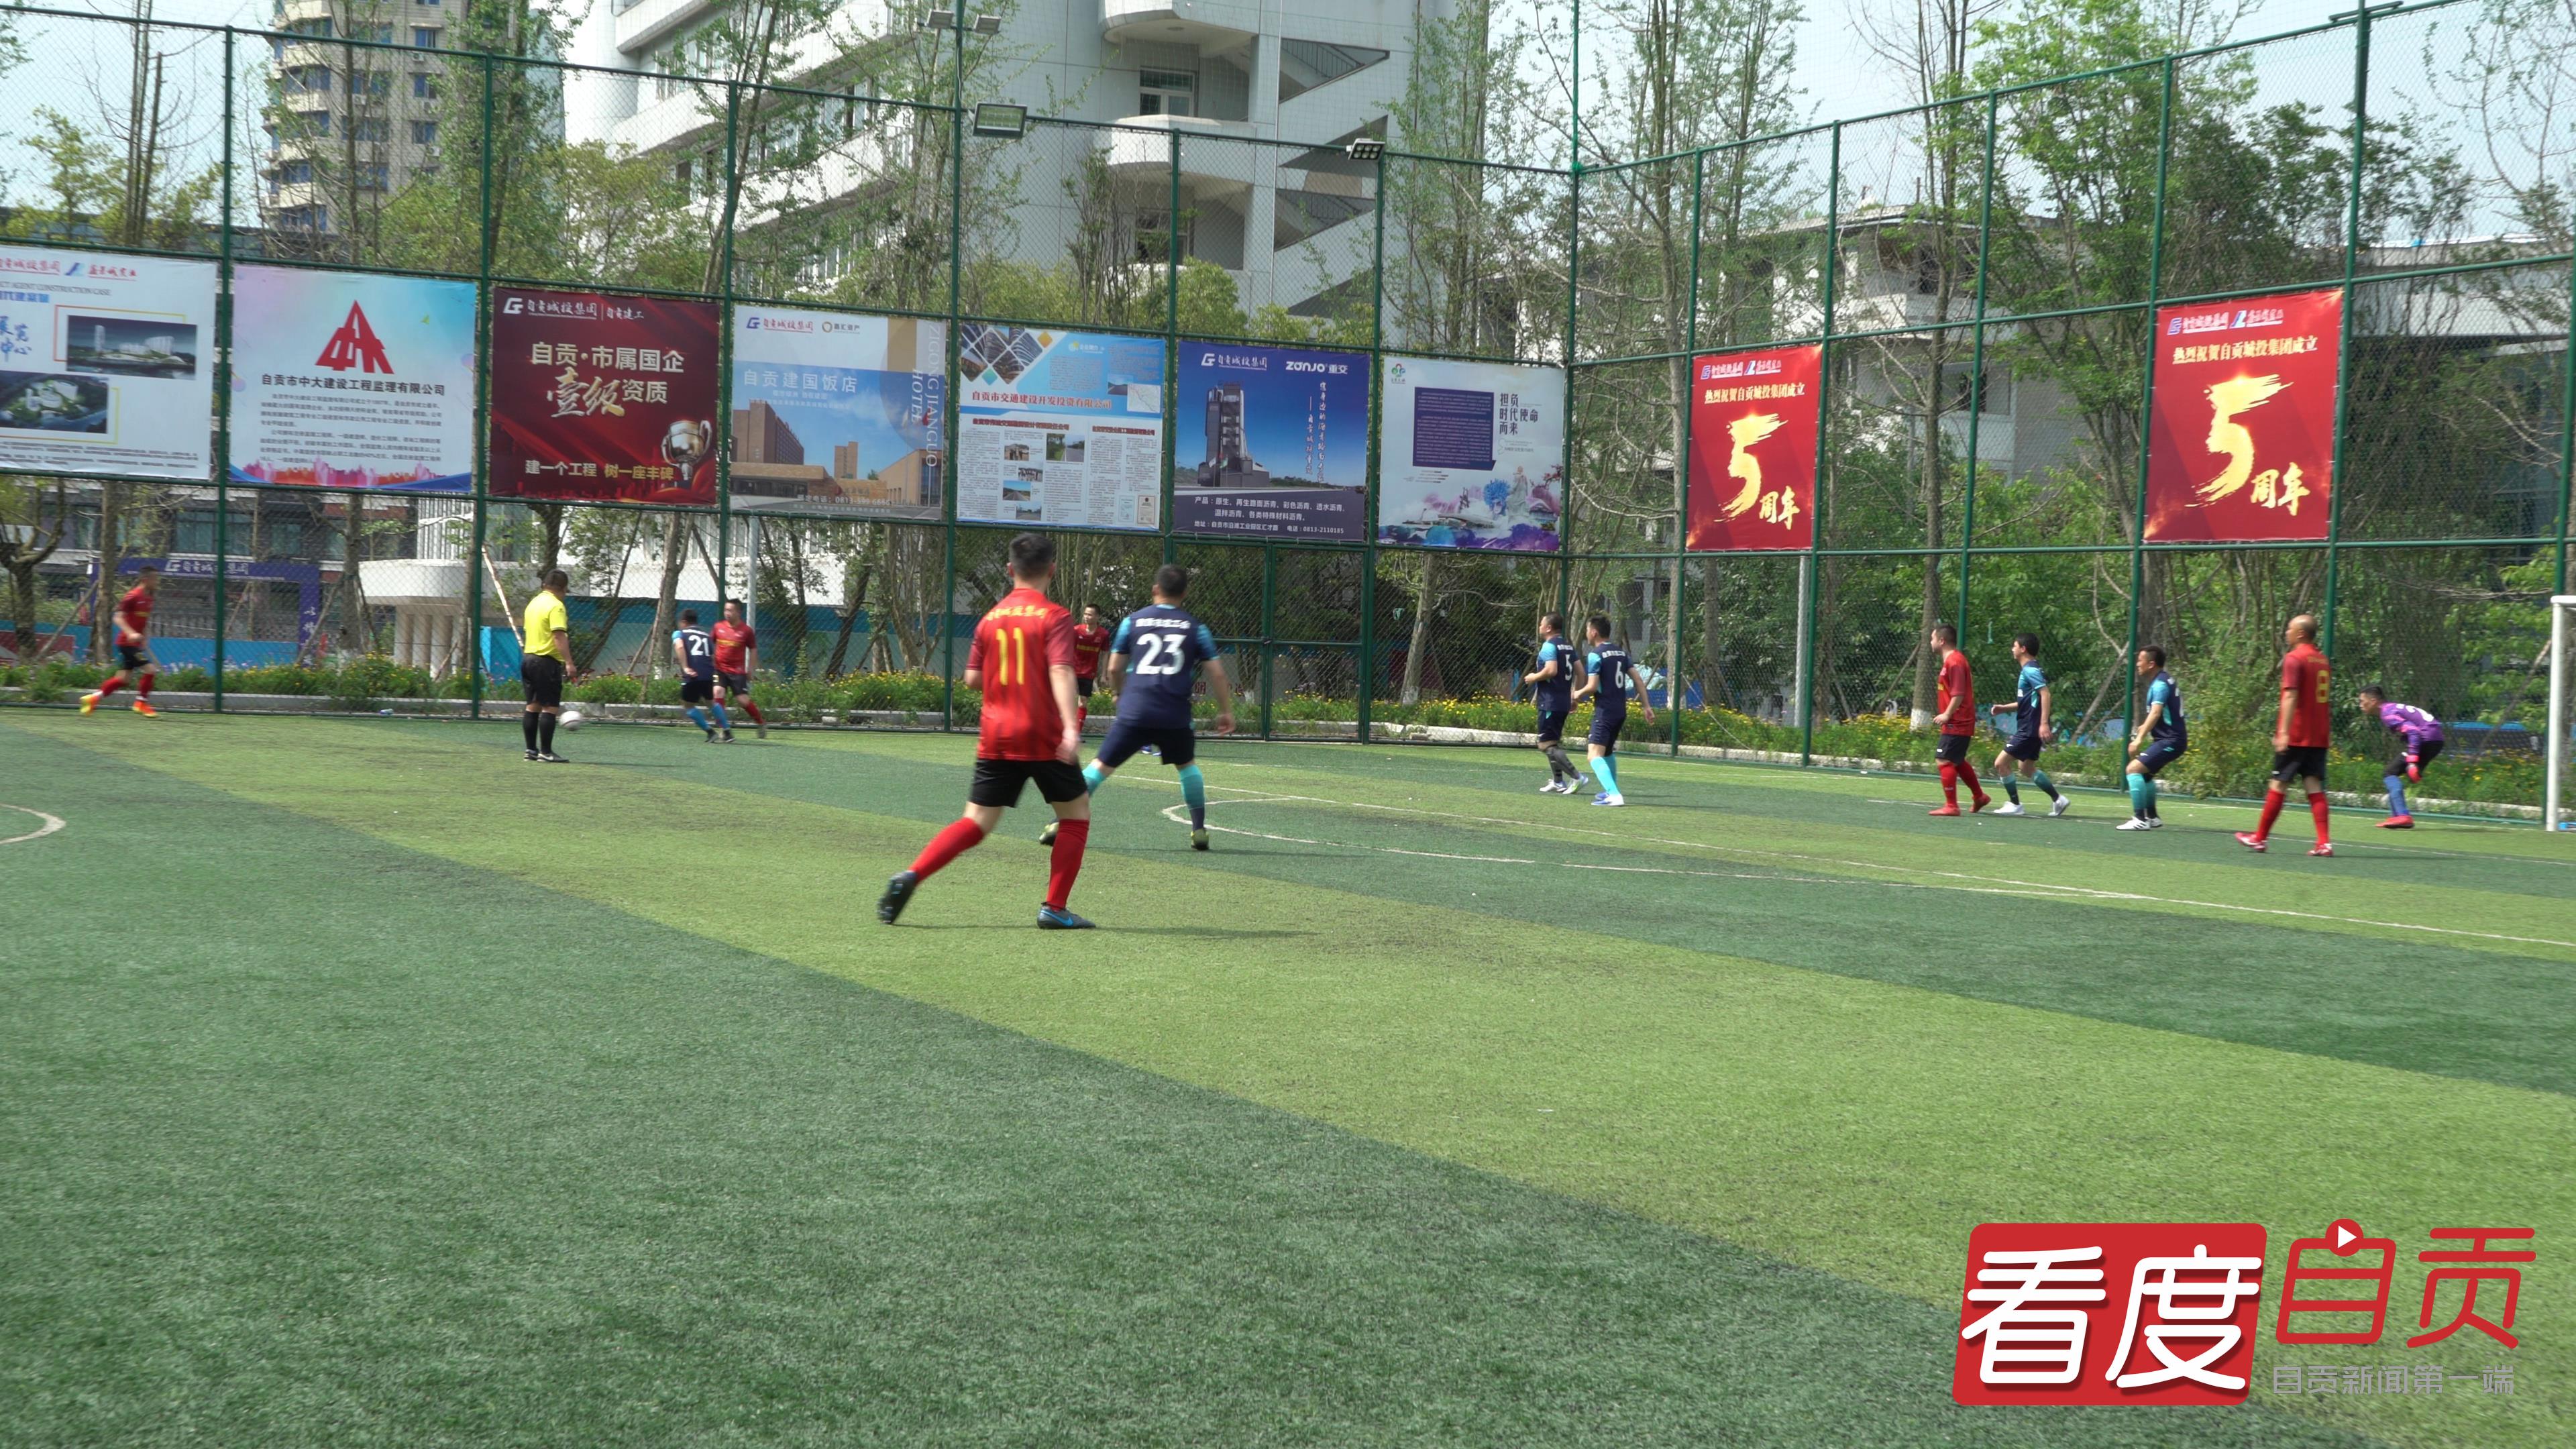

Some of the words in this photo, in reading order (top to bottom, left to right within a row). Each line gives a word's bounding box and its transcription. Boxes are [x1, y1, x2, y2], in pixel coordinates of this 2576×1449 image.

[262, 374, 445, 396] 自贡市中大建设工程监理有限公司
[743, 369, 858, 394] 自贡建国饭店
[972, 390, 1112, 409] 自贡市交通建设开发投资有限公司
[1500, 393, 1519, 408] 担负
[1499, 407, 1538, 423] 时代使命
[1499, 421, 1518, 435] 而来
[2184, 374, 2294, 508] 5
[525, 460, 597, 477] 建一个工程
[604, 463, 674, 481] 树一座丰碑
[1713, 413, 1788, 523] 5
[2250, 462, 2310, 516] 周年
[1759, 486, 1801, 530] 周年
[183, 561, 249, 575] 自贡城集团
[688, 635, 710, 657] 21
[996, 628, 1024, 686] 11
[1136, 633, 1187, 676] 23
[1615, 661, 1623, 688] 6
